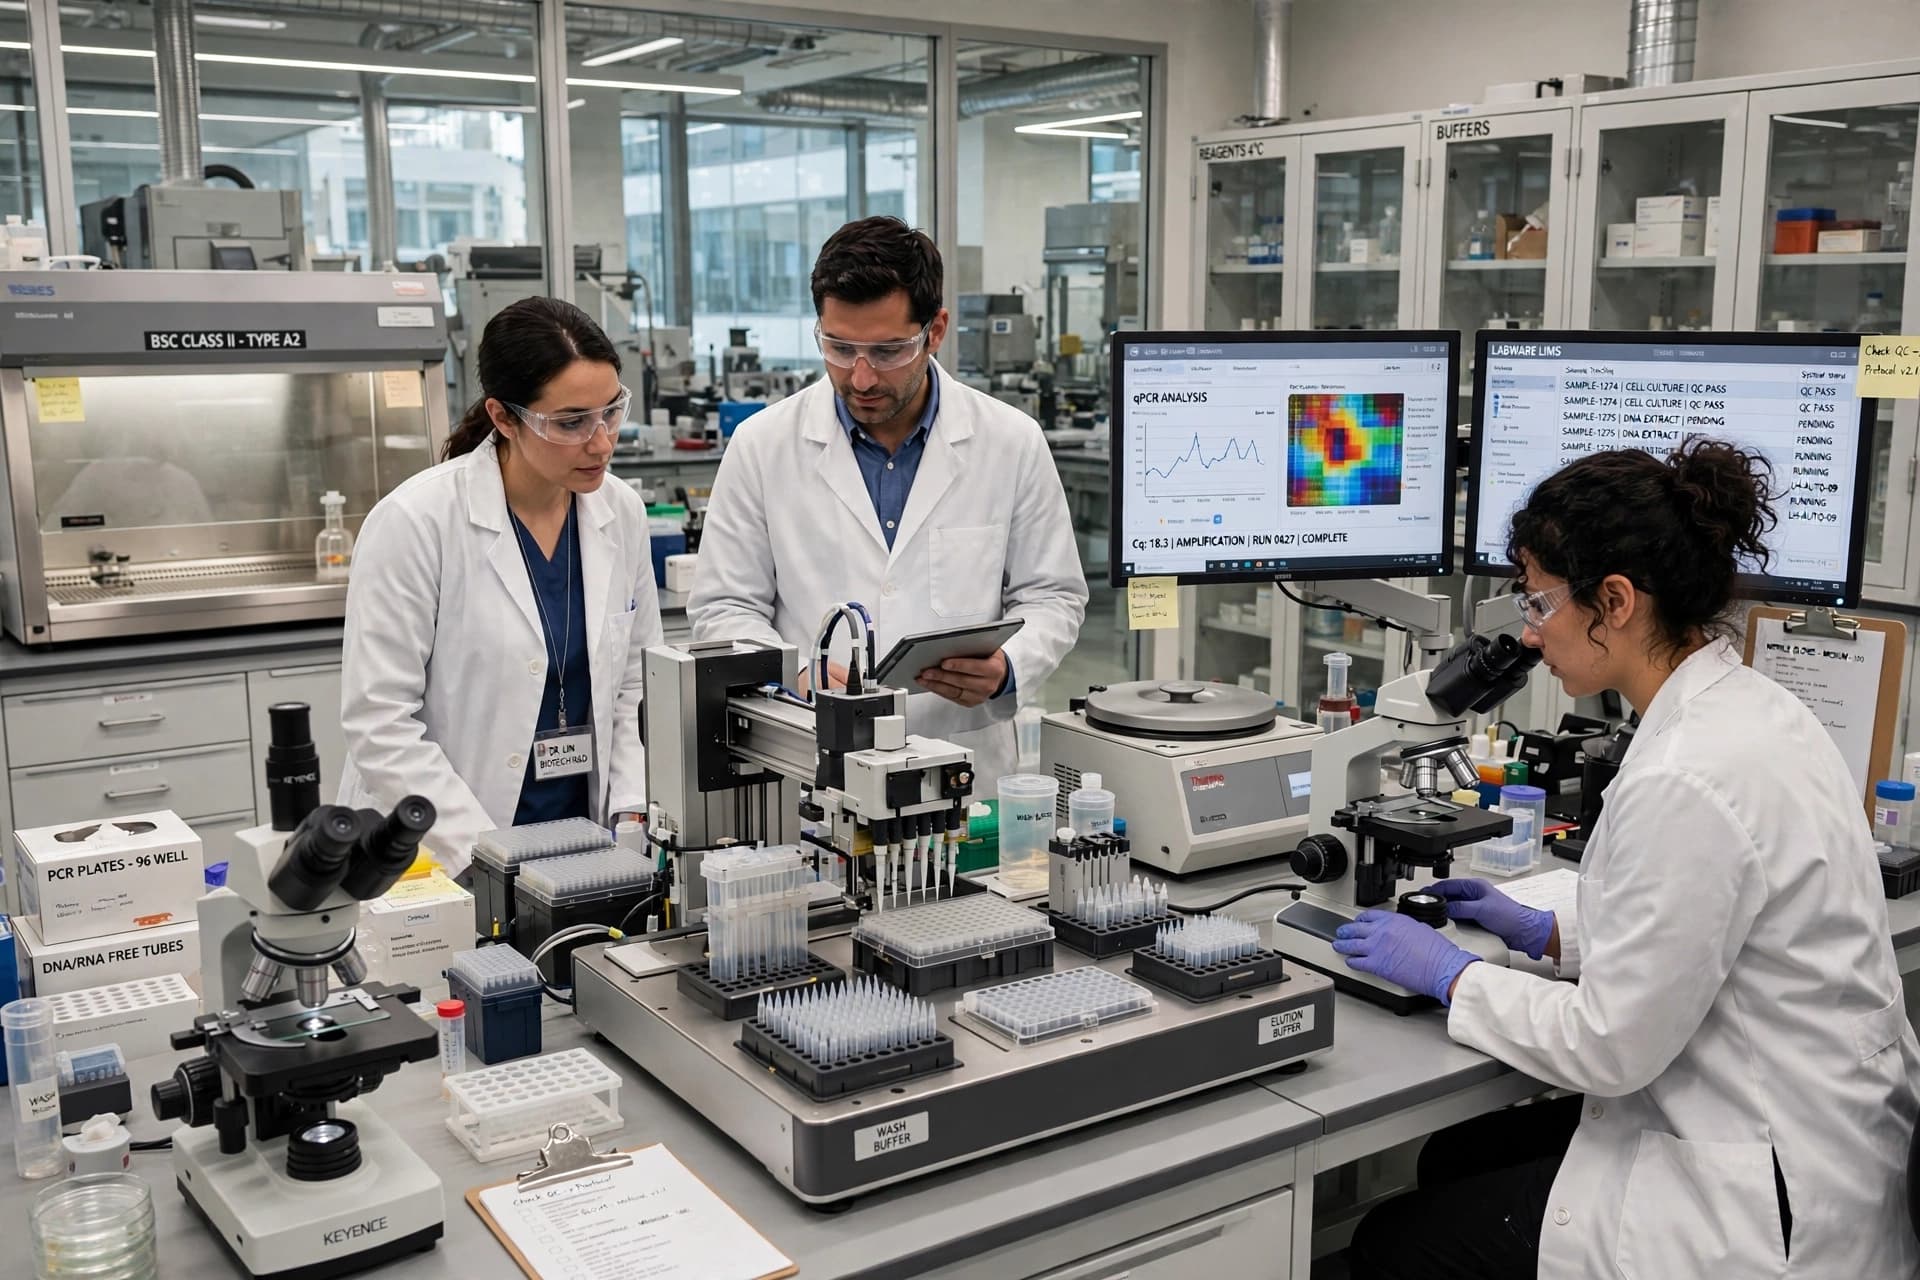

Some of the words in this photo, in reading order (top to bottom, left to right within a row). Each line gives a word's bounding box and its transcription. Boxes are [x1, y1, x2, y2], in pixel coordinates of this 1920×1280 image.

[1436, 120, 1490, 140] BUFFERS
[1199, 144, 1246, 160] REAGENTS
[150, 334, 178, 349] BSC
[181, 333, 224, 348] CLASS
[246, 333, 280, 347] TYPE
[283, 333, 301, 346] A2
[1491, 344, 1537, 356] LABWARE
[1538, 345, 1562, 357] LIMS
[1865, 345, 1890, 356] Check
[1895, 345, 1910, 357] QC
[1625, 382, 1645, 392] CELL
[1646, 383, 1684, 393] CULTURE
[1690, 384, 1703, 394] QC
[1705, 384, 1727, 394] PASS
[1800, 387, 1813, 397] QC
[1815, 387, 1836, 396] PASS
[1133, 392, 1159, 405] qPCR
[1161, 391, 1208, 403] ANALYSIS
[1624, 398, 1643, 408] CELL
[1645, 399, 1682, 409] CULTURE
[1689, 400, 1702, 410] QC
[1704, 400, 1725, 409] PASS
[1799, 403, 1812, 413] QC
[1623, 414, 1641, 423] DNA
[1643, 414, 1681, 424] EXTRACT
[1687, 416, 1725, 426] PENDING
[1798, 420, 1835, 429] PENDING
[1622, 430, 1639, 438] DNA
[1642, 430, 1679, 440] EXTRACT
[1796, 436, 1833, 445] PENDING
[1132, 538, 1147, 550] Cq:
[1149, 538, 1169, 549] 18.3
[1176, 535, 1245, 548] AMPLIFICATION
[1252, 534, 1272, 545] RUN
[1301, 533, 1348, 544] COMPLETE
[47, 867, 74, 882] PCR
[77, 858, 126, 876] PLATES
[135, 855, 151, 868] 96
[153, 850, 189, 865] WELL
[42, 953, 105, 974] DNA/RNA
[108, 947, 140, 963] FREE
[142, 939, 184, 957] TUBES
[1271, 1010, 1304, 1027] ELUTION
[1272, 1022, 1301, 1038] BUFFER
[876, 1120, 906, 1137] WASH
[873, 1132, 911, 1152] BUFFER
[323, 1215, 389, 1246] KEYENCE
